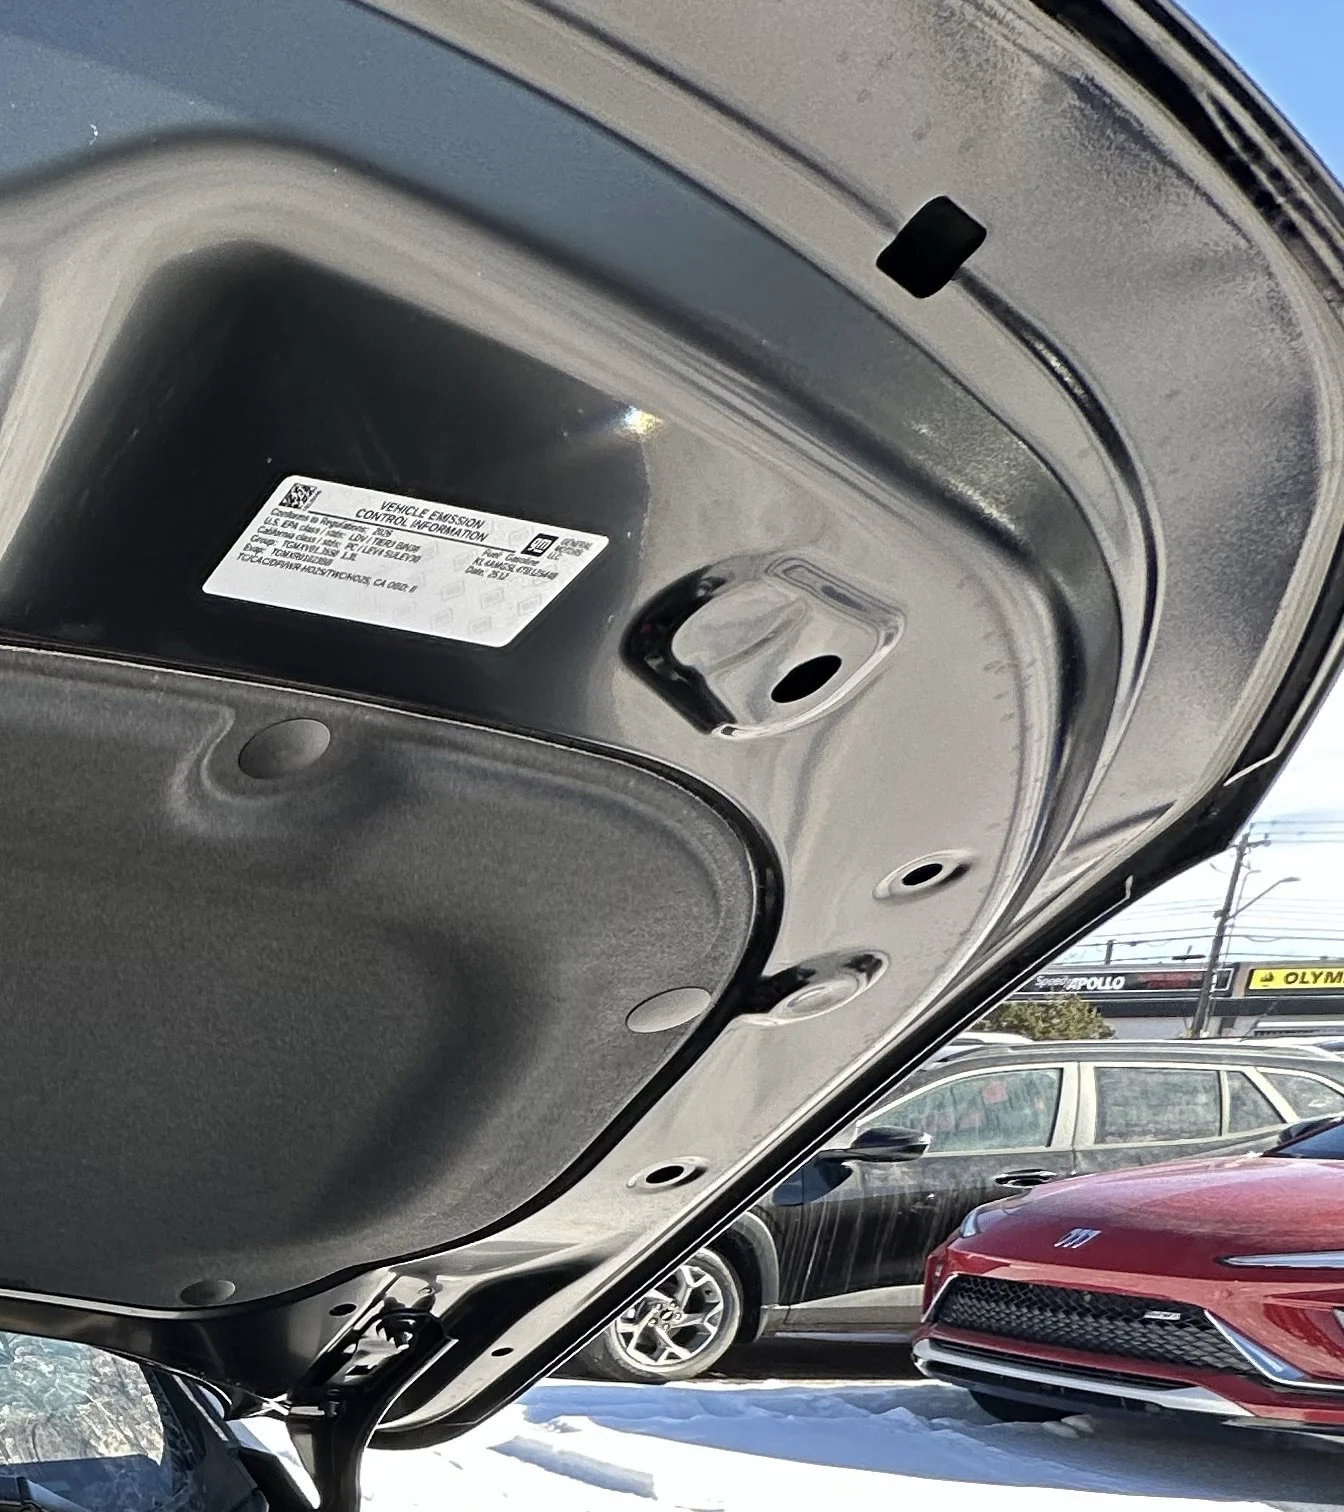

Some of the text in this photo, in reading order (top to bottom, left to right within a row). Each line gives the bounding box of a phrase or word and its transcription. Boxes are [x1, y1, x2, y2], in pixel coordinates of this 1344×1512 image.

[355, 508, 488, 541] CONTROL INFORMATION
[380, 501, 485, 529] VEHICLE EMISSION
[257, 525, 295, 539] California
[344, 542, 358, 551] PC
[280, 520, 299, 529] EPA
[348, 533, 368, 542] LDV
[505, 553, 540, 566] Gasoline
[373, 578, 386, 587] CA
[1066, 975, 1126, 991] APOLLO
[1283, 970, 1344, 985] OLYM
